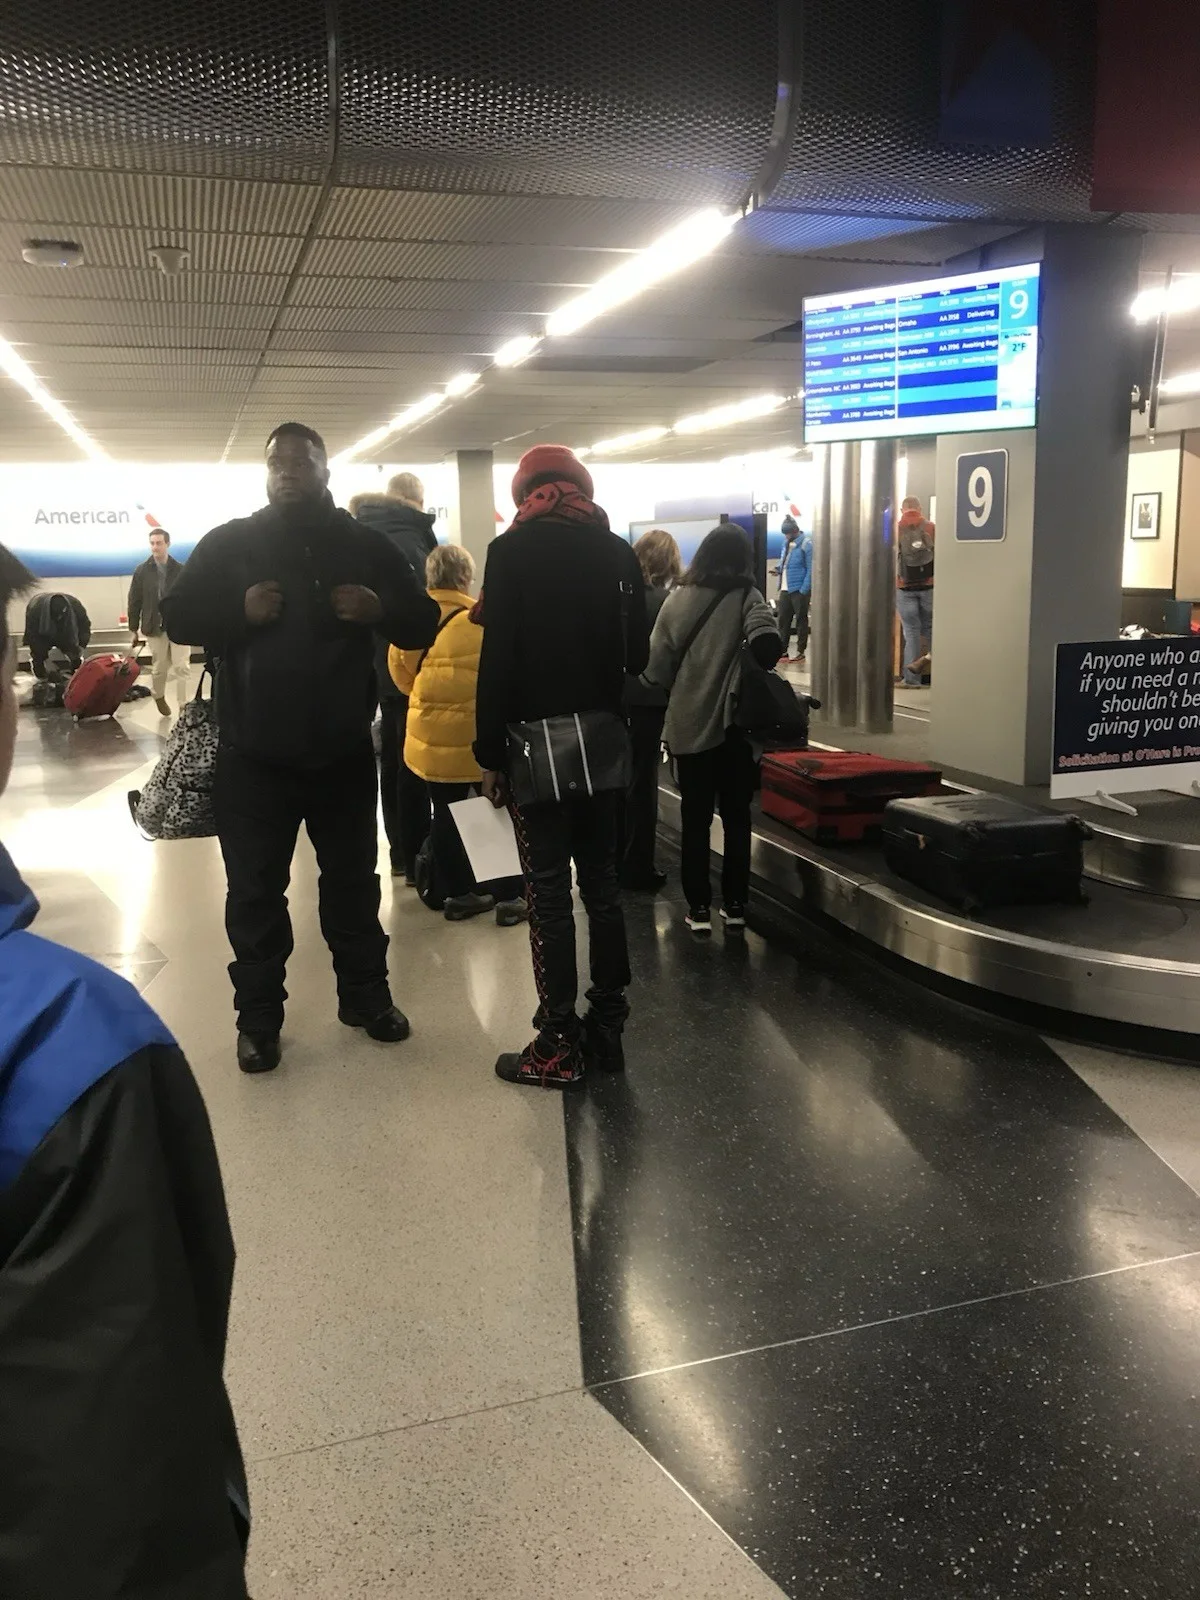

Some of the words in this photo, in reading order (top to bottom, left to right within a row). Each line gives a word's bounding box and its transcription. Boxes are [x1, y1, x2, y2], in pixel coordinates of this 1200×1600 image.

[967, 310, 995, 318] Delivering
[1010, 290, 1028, 319] 9
[968, 466, 993, 527] 9
[35, 508, 130, 524] American
[1080, 652, 1145, 674] Anyone
[1150, 646, 1184, 666] who
[1080, 673, 1094, 692] if
[1095, 676, 1127, 696] you
[1132, 668, 1174, 689] need
[1178, 672, 1188, 686] a
[1101, 690, 1178, 713] shouldn't
[1181, 689, 1200, 707] be
[1087, 716, 1140, 742] giving
[1143, 717, 1174, 737] you
[1178, 715, 1200, 729] on
[1058, 752, 1120, 767] Solicitation
[1121, 751, 1133, 762] at
[1172, 746, 1182, 757] is
